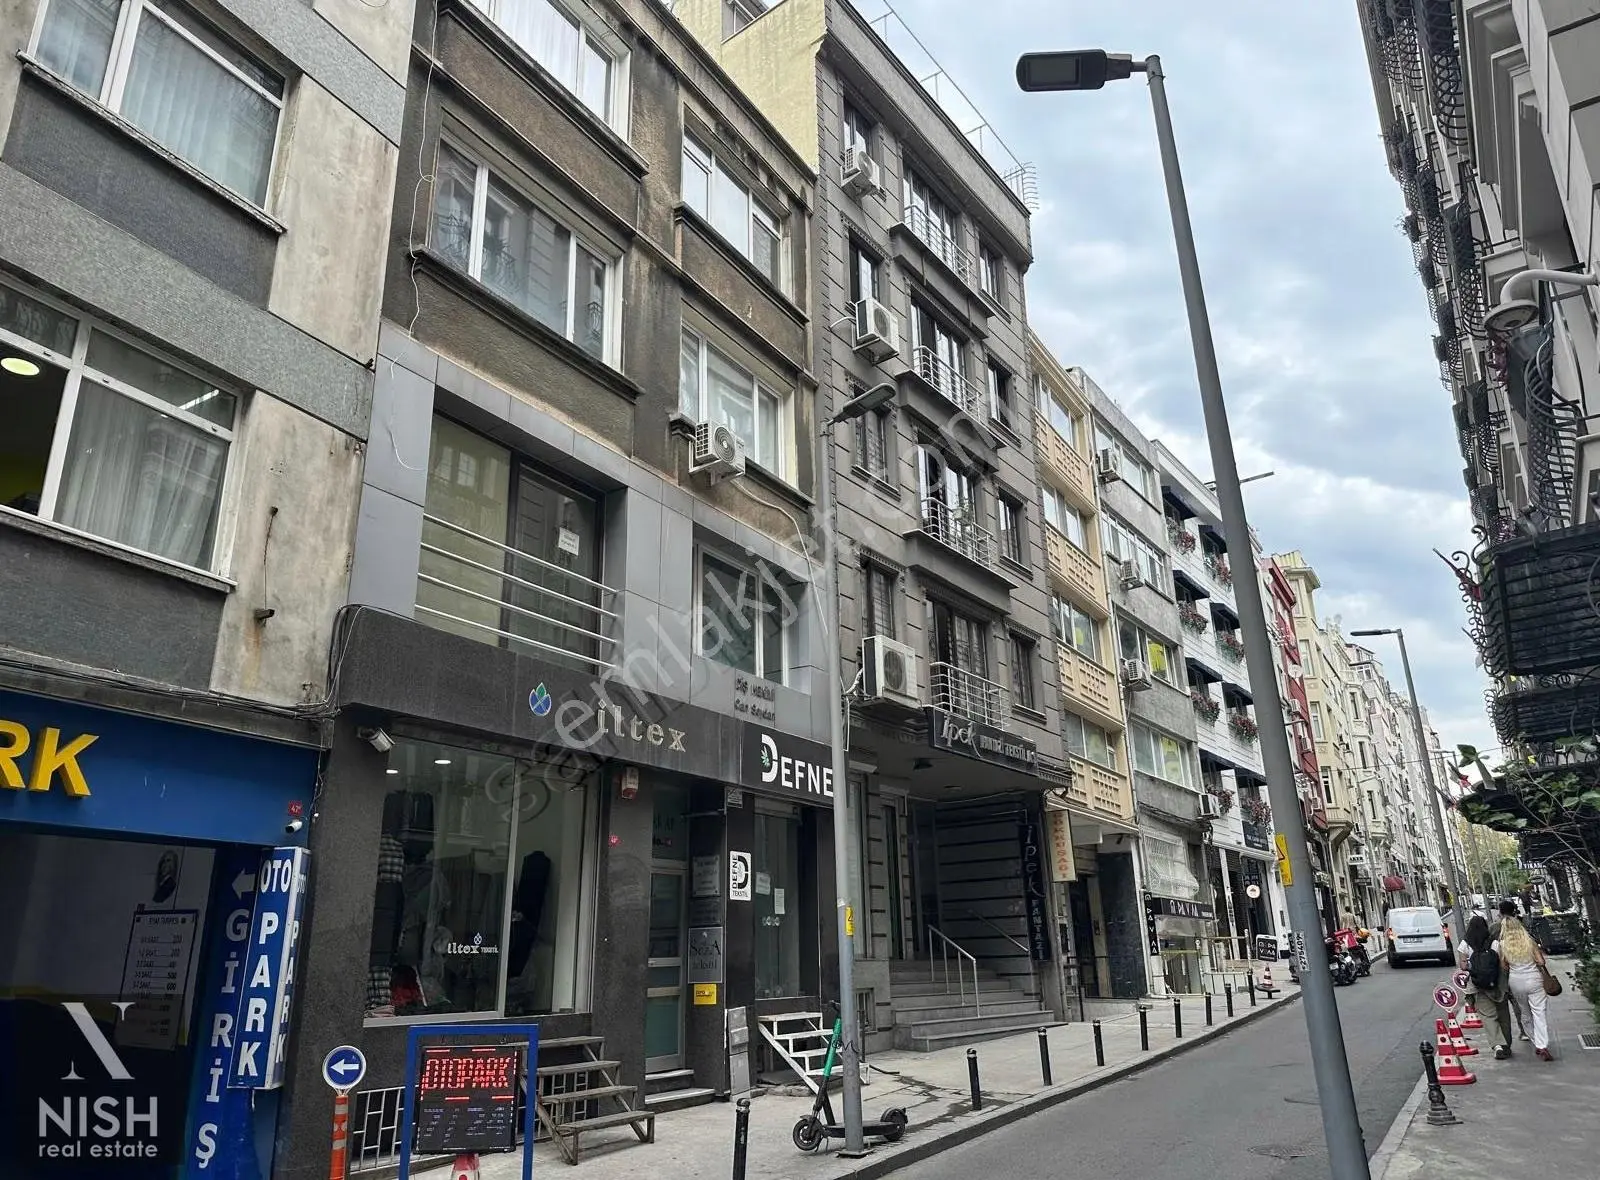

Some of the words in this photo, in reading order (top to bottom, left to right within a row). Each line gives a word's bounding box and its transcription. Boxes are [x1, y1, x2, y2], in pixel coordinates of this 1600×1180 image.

[761, 733, 835, 798] DEFNE
[260, 860, 292, 894] OTO
[195, 908, 250, 1169] GİRİŞ
[237, 911, 279, 1077] PARK
